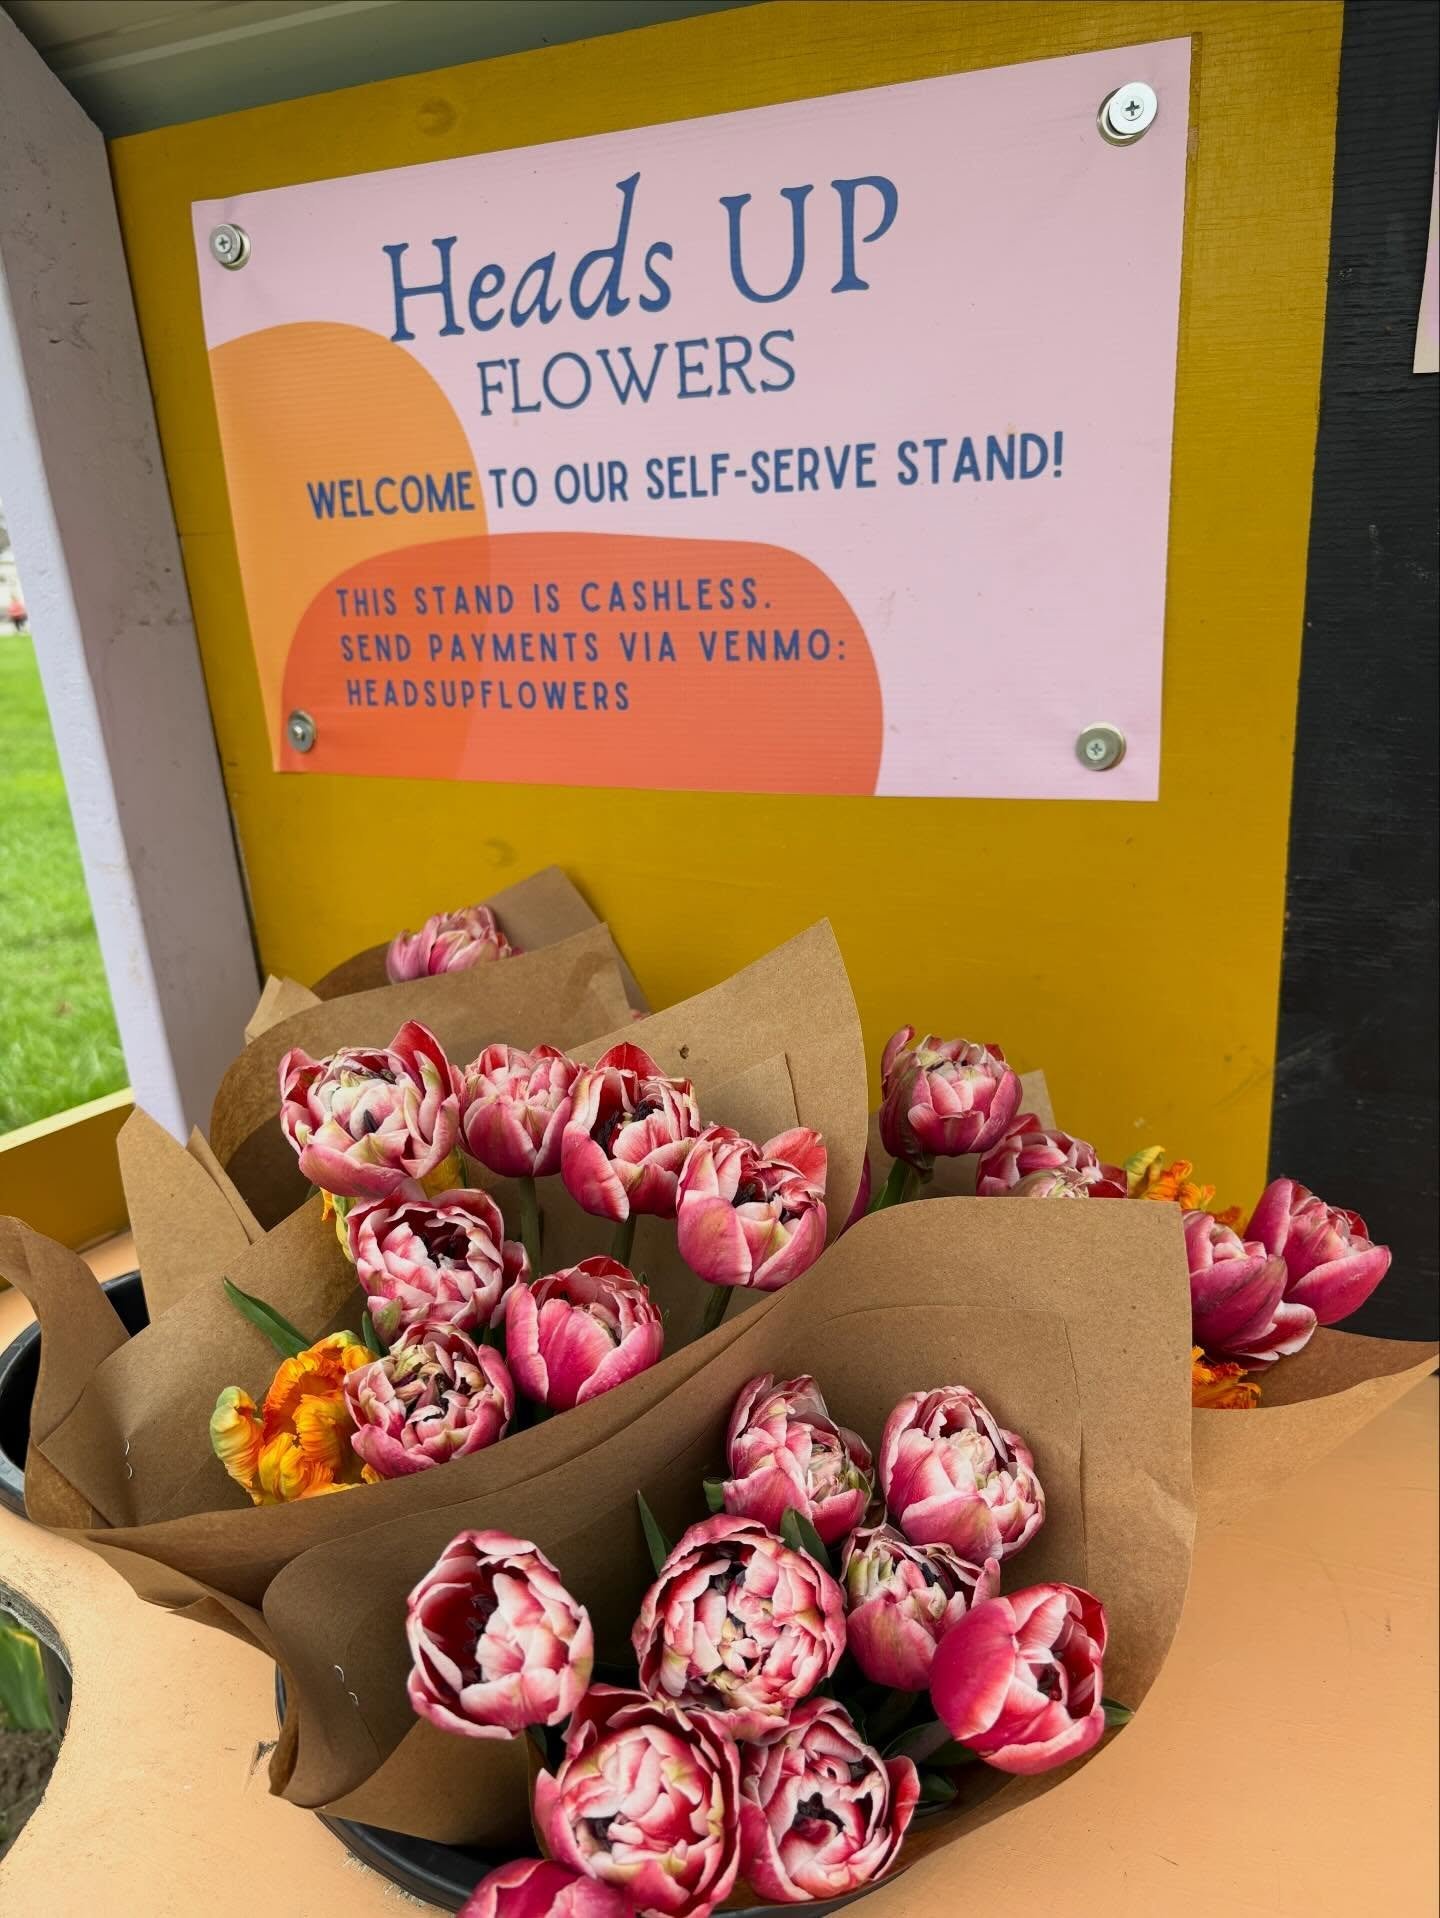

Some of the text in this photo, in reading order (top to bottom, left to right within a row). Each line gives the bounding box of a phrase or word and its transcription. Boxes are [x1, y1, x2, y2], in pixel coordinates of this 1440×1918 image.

[382, 172, 900, 343] Heads UP
[476, 329, 797, 418] FLOWERS
[307, 430, 1066, 520] WELCOME TO OUR SELF-SERVE STAND!
[335, 577, 773, 617] THIS STAND IS CASHLESS.
[340, 627, 848, 662] SEND PAYMENTS VIA VENMO:
[346, 680, 632, 711] HEADSUPFLOWERS
